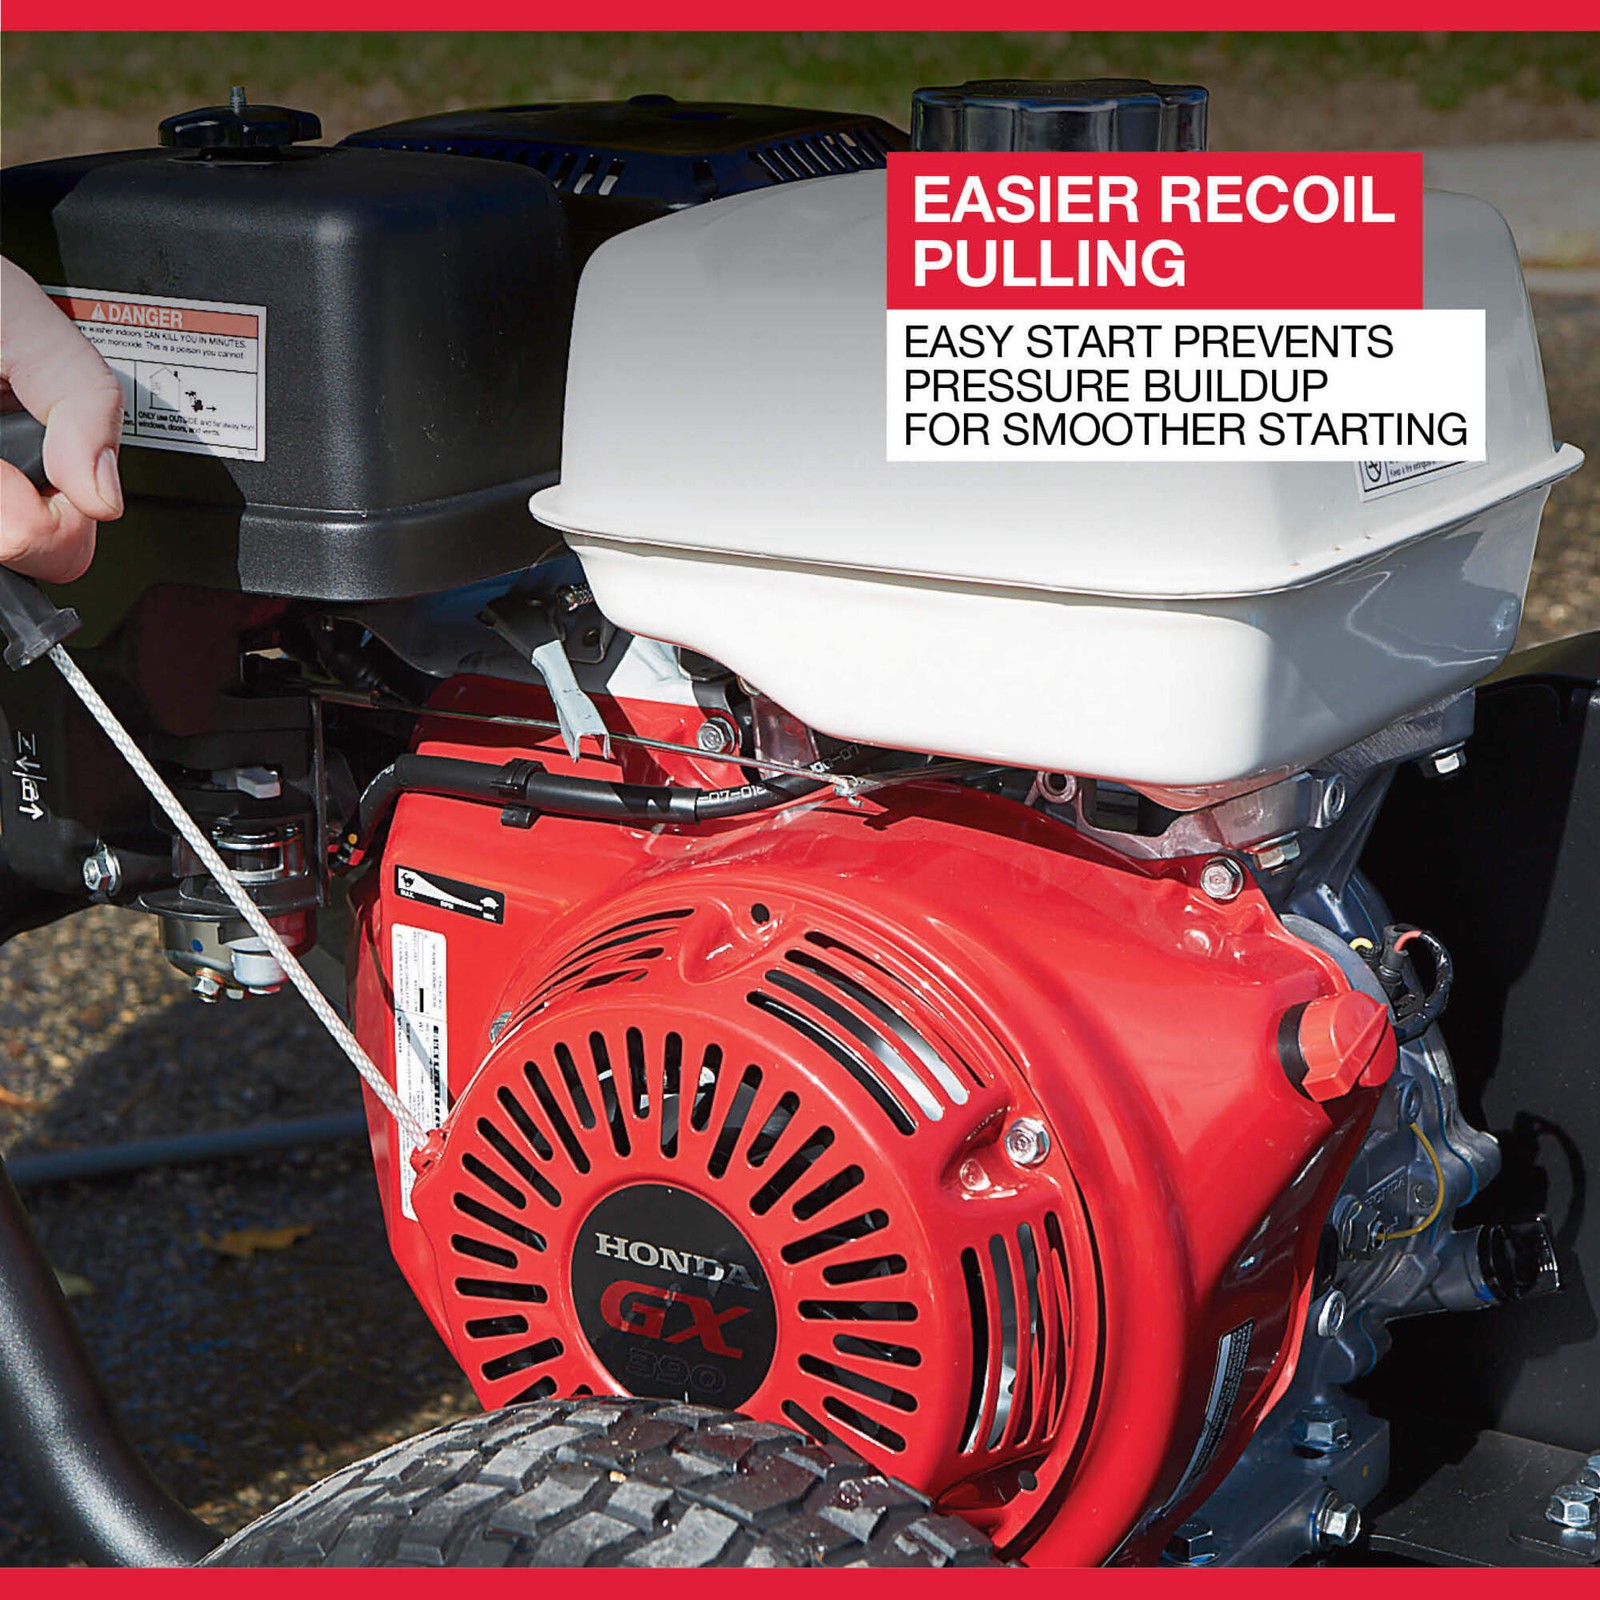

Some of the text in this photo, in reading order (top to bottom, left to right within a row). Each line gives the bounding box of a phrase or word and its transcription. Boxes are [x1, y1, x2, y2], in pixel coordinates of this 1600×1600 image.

[108, 304, 183, 329] DANGER
[116, 329, 142, 338] indoors
[144, 331, 160, 339] CAN
[162, 332, 178, 342] KILL
[181, 334, 197, 344] YOU
[199, 336, 207, 345] IN
[146, 340, 160, 351] This
[176, 346, 201, 355] poison
[203, 348, 216, 357] you
[218, 350, 244, 359] cannot
[138, 411, 156, 420] ONLY
[594, 1232, 760, 1290] HONDA
[600, 1279, 753, 1360] GX
[624, 1346, 727, 1393] 390
